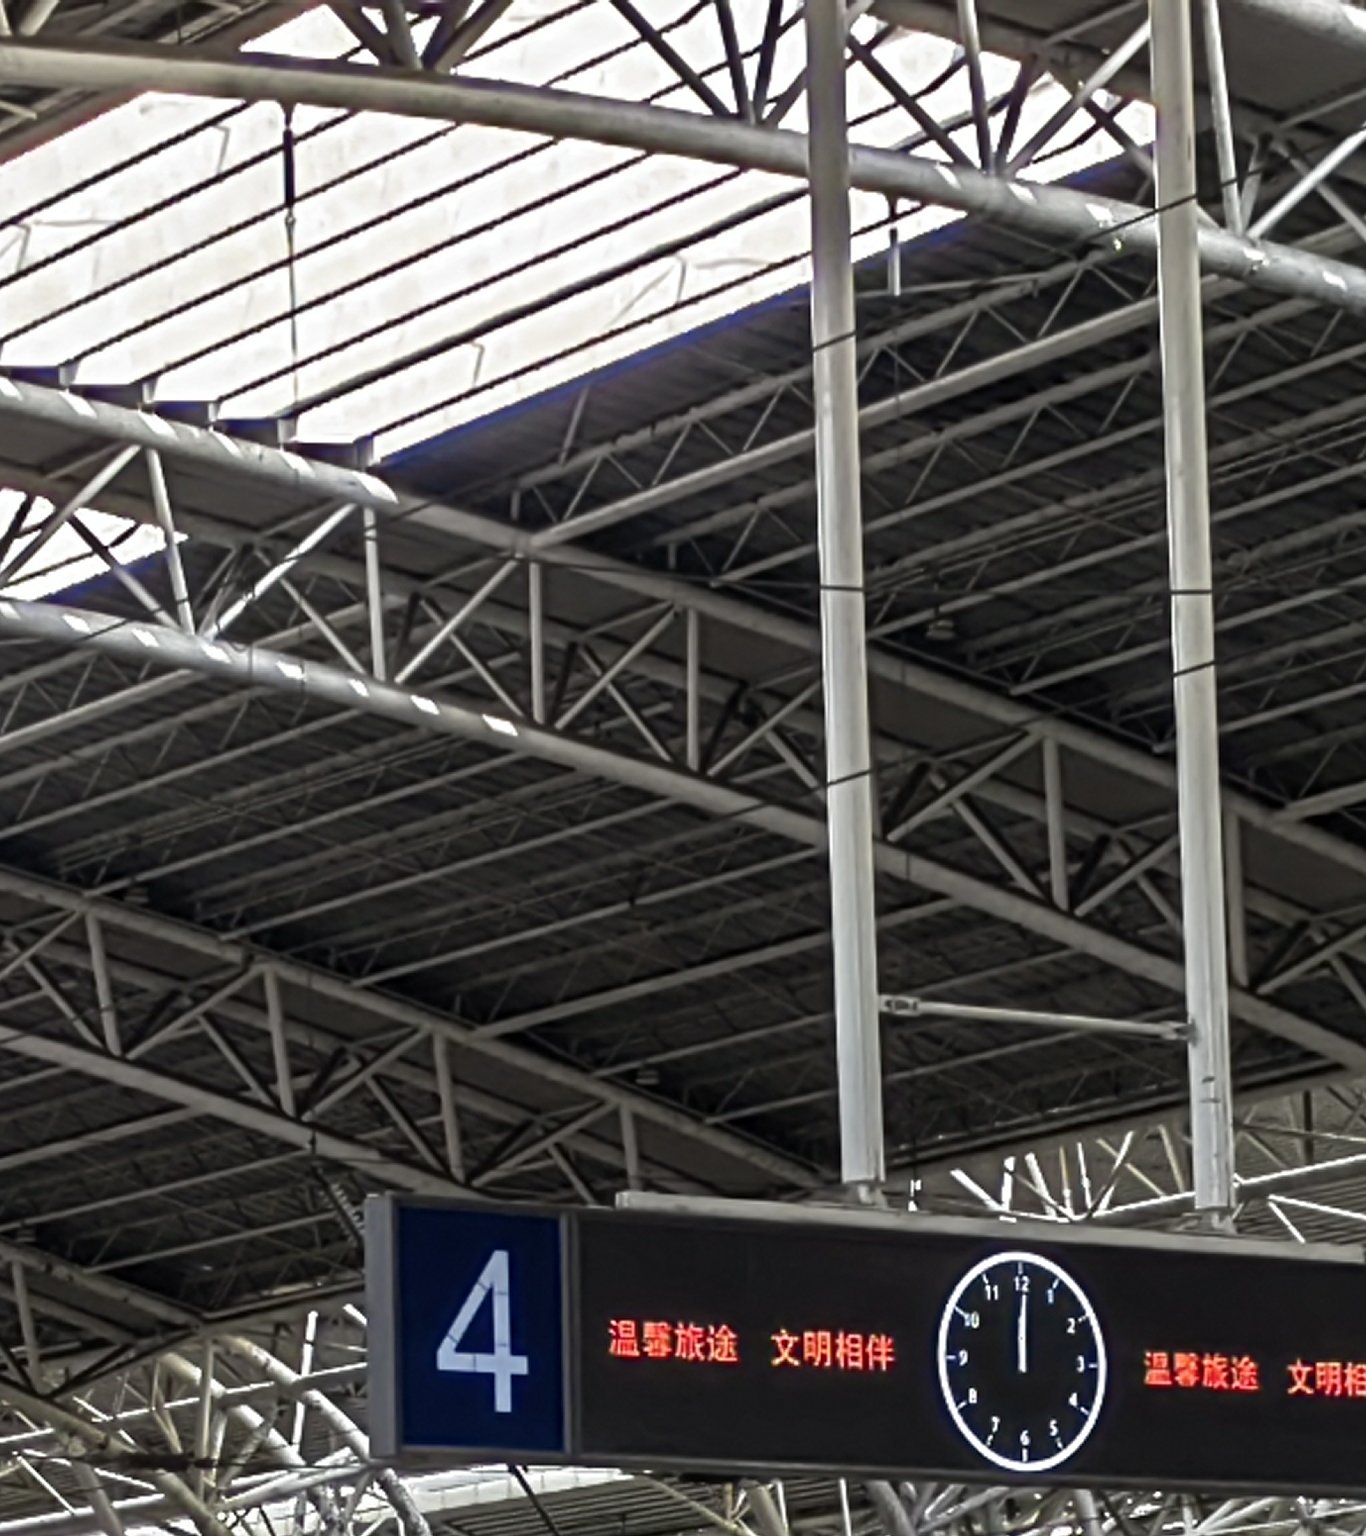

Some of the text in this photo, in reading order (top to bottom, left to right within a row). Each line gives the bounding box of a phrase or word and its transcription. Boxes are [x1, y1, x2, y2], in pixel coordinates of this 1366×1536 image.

[985, 1284, 999, 1301] 11
[1014, 1275, 1030, 1293] 12
[964, 1310, 980, 1329] 10
[1066, 1317, 1076, 1335] 2
[436, 1248, 527, 1414] 4
[608, 1319, 896, 1372] 温馨旅途 文明相伴
[958, 1349, 968, 1366] 9
[1076, 1355, 1086, 1373] 3
[1143, 1351, 1260, 1391] 温馨旅途
[968, 1387, 978, 1404] 8
[1068, 1391, 1078, 1409] 4
[991, 1415, 1001, 1433] 7
[1049, 1419, 1058, 1437] 5
[1019, 1429, 1030, 1446] 6
